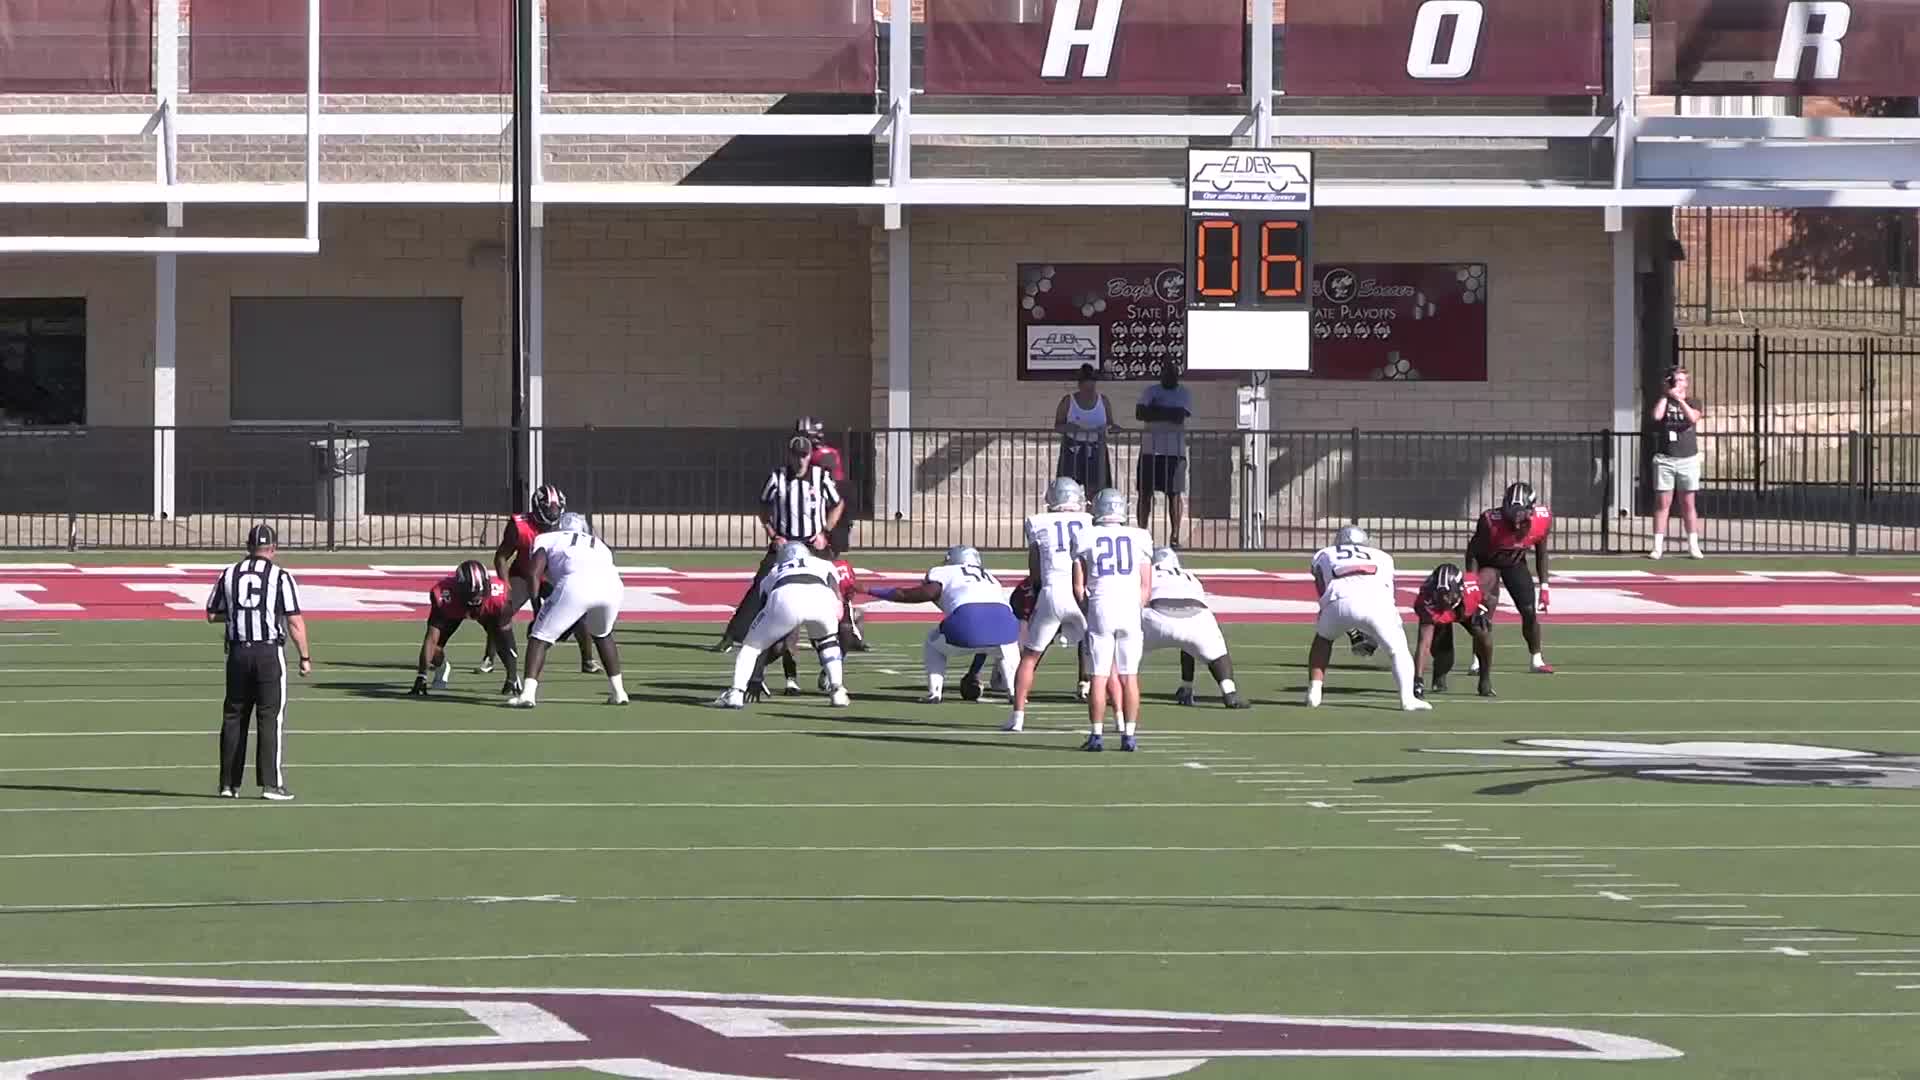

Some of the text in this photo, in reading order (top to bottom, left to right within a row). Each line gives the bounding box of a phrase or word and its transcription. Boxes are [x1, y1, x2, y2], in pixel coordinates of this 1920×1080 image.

[1041, 0, 1850, 79] H O R
[1221, 156, 1276, 174] ELDER
[1198, 221, 1302, 296] 06
[1107, 277, 1154, 302] Boy's
[1127, 304, 1161, 319] STATE
[1341, 305, 1397, 319] PLAYOFFS
[1096, 535, 1134, 576] 20
[1336, 544, 1372, 560] 55
[238, 573, 263, 608] C
